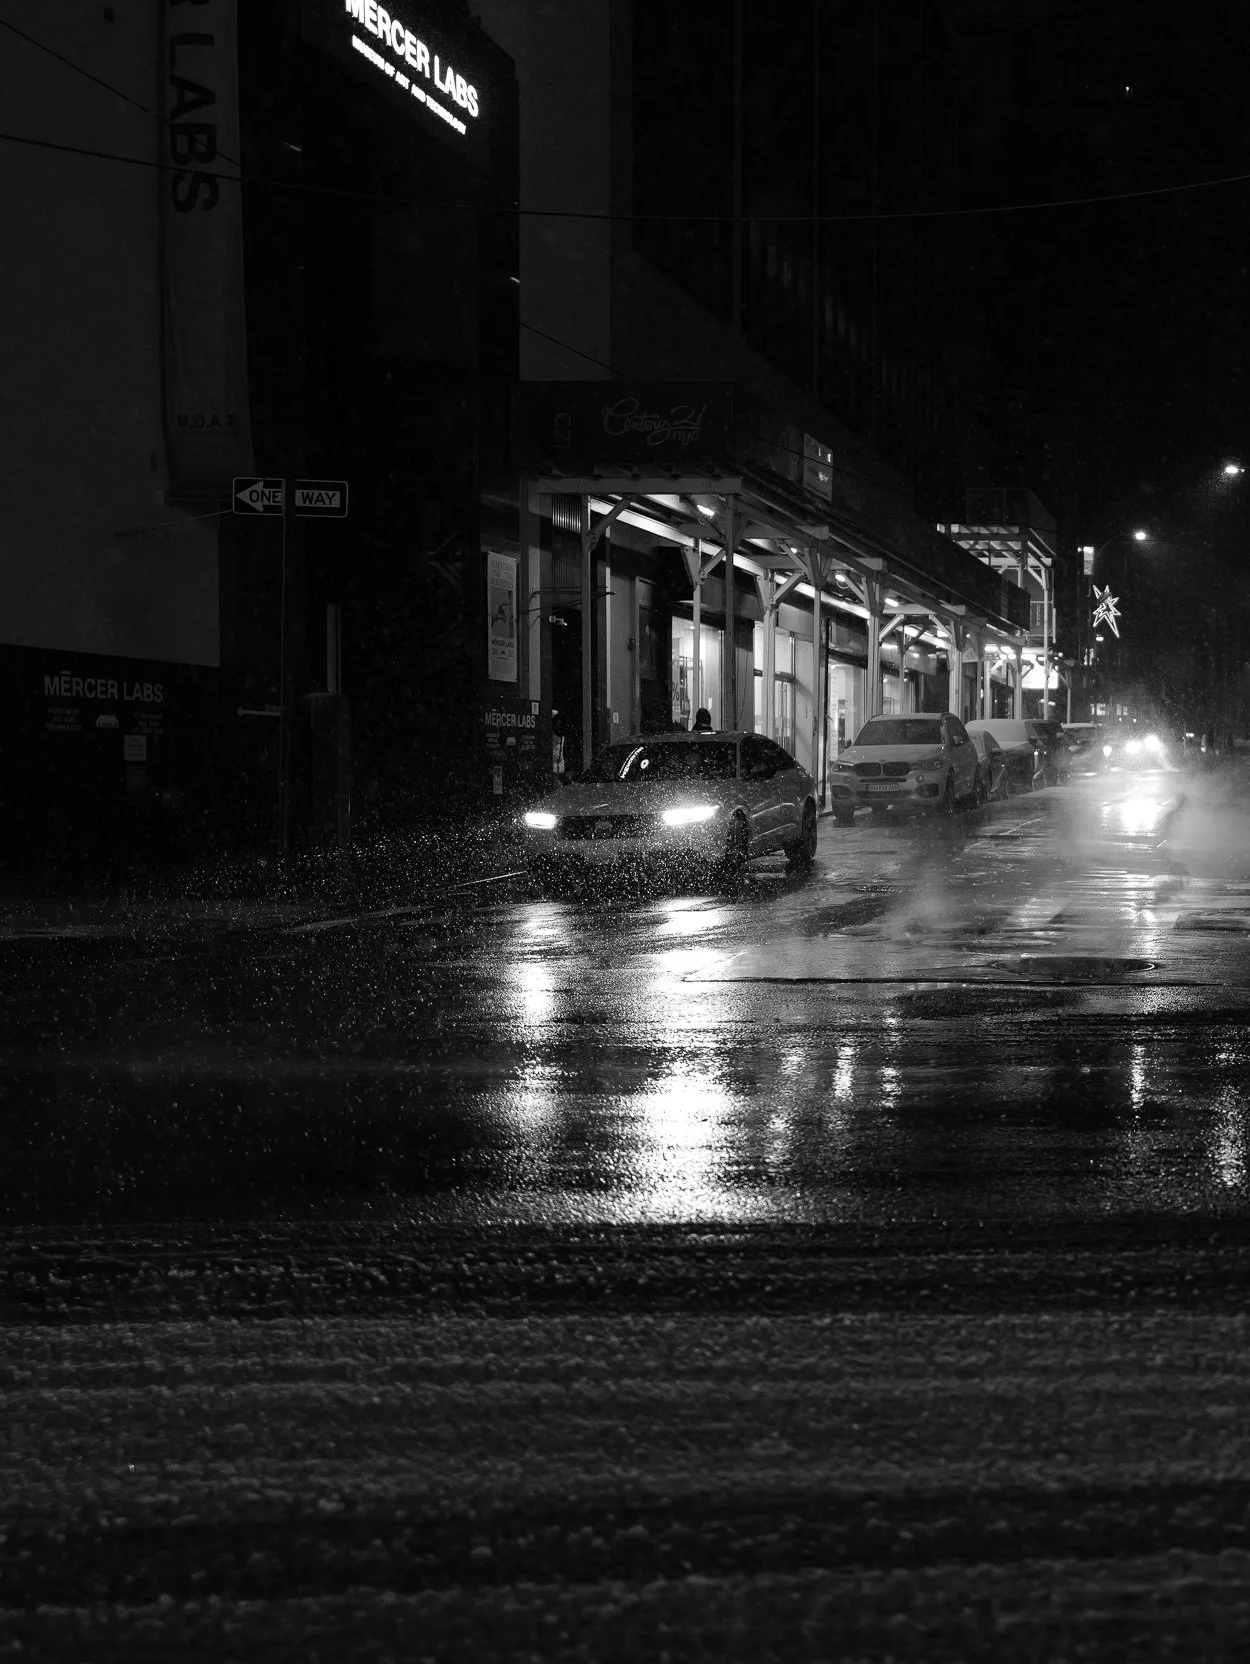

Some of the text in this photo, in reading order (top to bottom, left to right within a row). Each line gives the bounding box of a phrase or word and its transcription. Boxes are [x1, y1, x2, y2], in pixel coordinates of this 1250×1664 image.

[434, 54, 479, 118] LABS
[170, 33, 219, 212] LABS
[248, 489, 337, 506] ONE WAY
[123, 681, 164, 703] LABS
[517, 714, 536, 729] LABS
